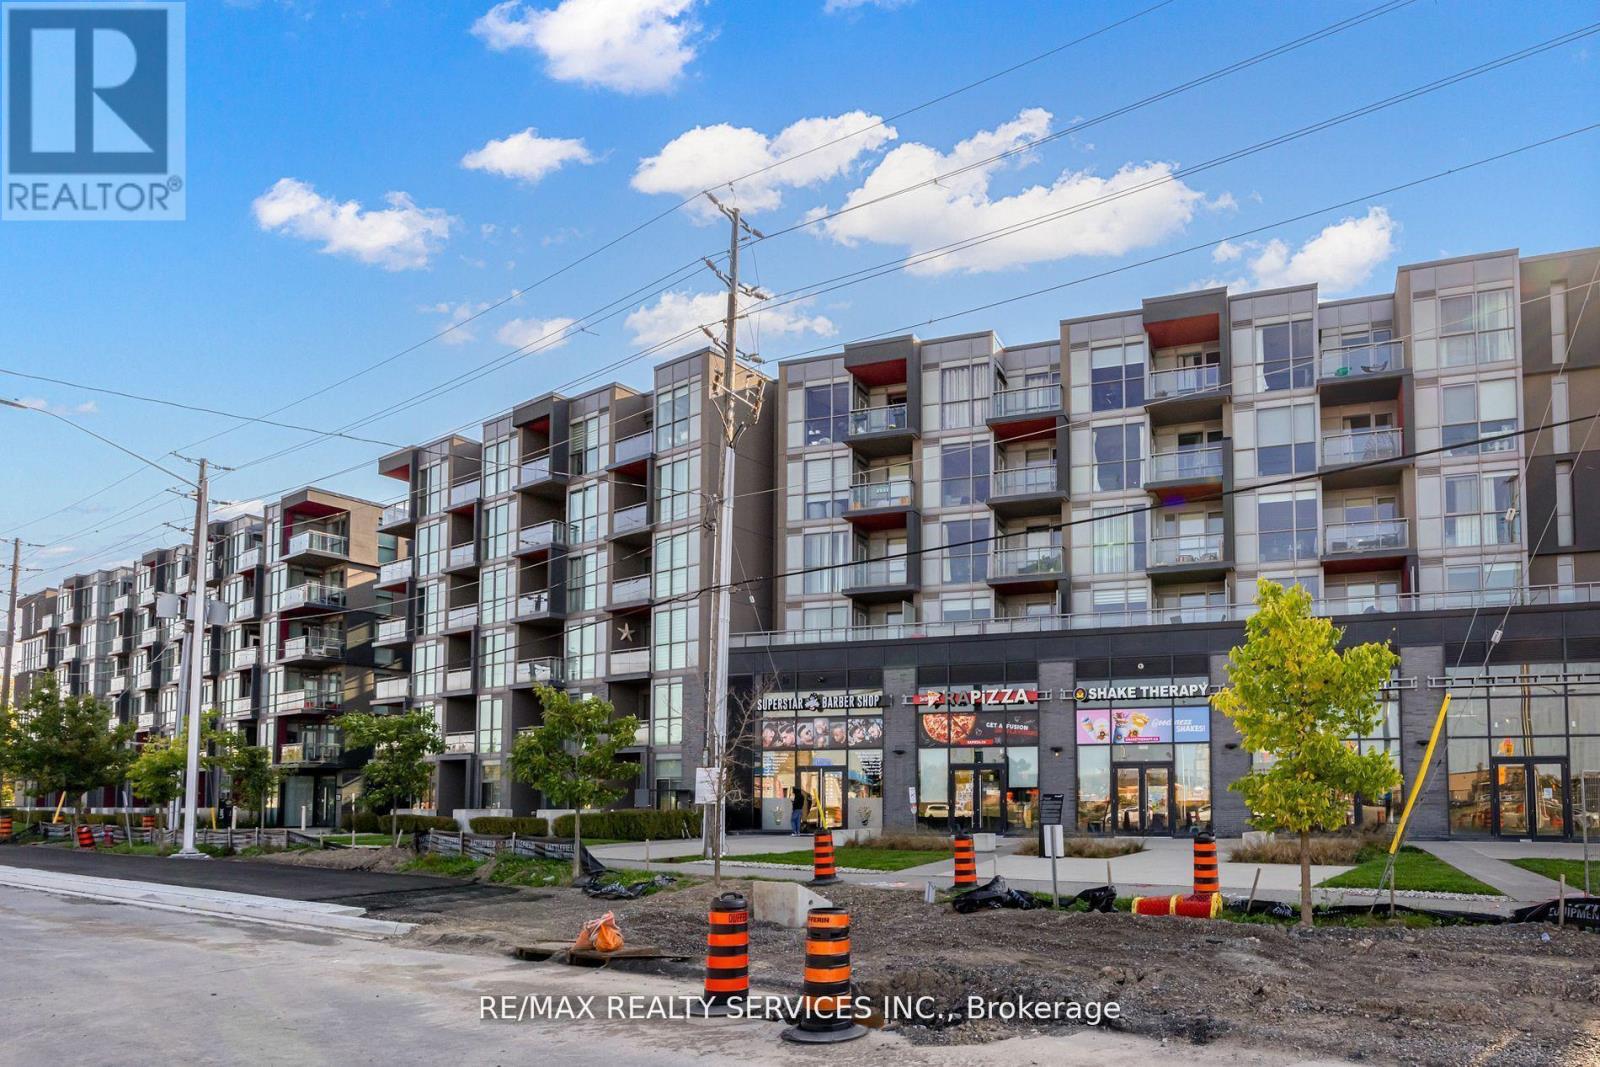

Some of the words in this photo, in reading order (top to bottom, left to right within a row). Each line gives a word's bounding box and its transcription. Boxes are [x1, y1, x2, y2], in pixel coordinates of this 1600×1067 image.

[1088, 686, 1137, 700] SHAKE
[1140, 683, 1209, 698] THERAPY
[757, 697, 804, 711] SUPERSTAR
[822, 695, 856, 709] BARBER
[857, 694, 880, 708] SHOP
